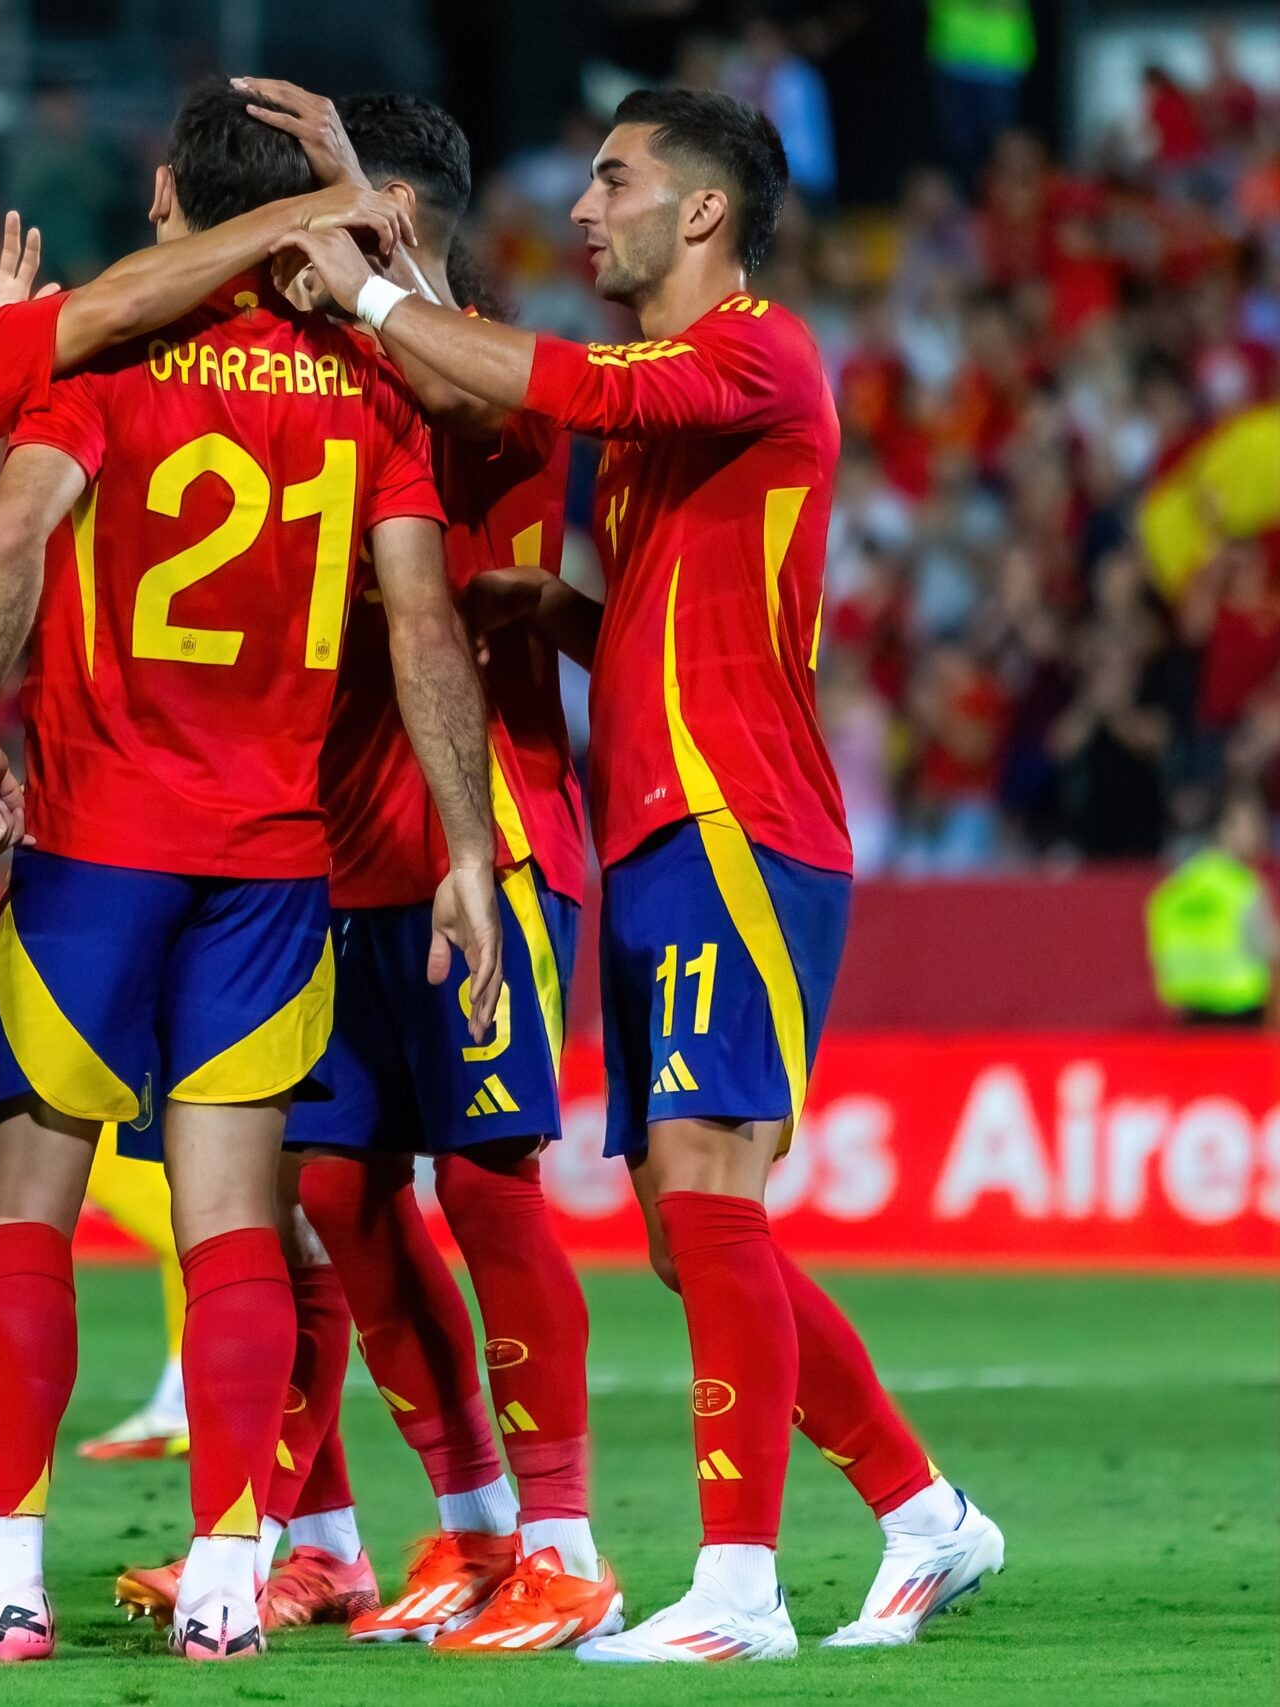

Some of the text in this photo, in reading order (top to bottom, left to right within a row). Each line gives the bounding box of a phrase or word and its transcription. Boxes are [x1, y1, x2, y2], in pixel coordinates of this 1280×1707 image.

[148, 339, 363, 397] OYARZABAL
[131, 432, 358, 670] 21
[458, 973, 511, 1062] 9
[655, 942, 718, 1038] 11
[930, 1057, 1280, 1228] Aire
